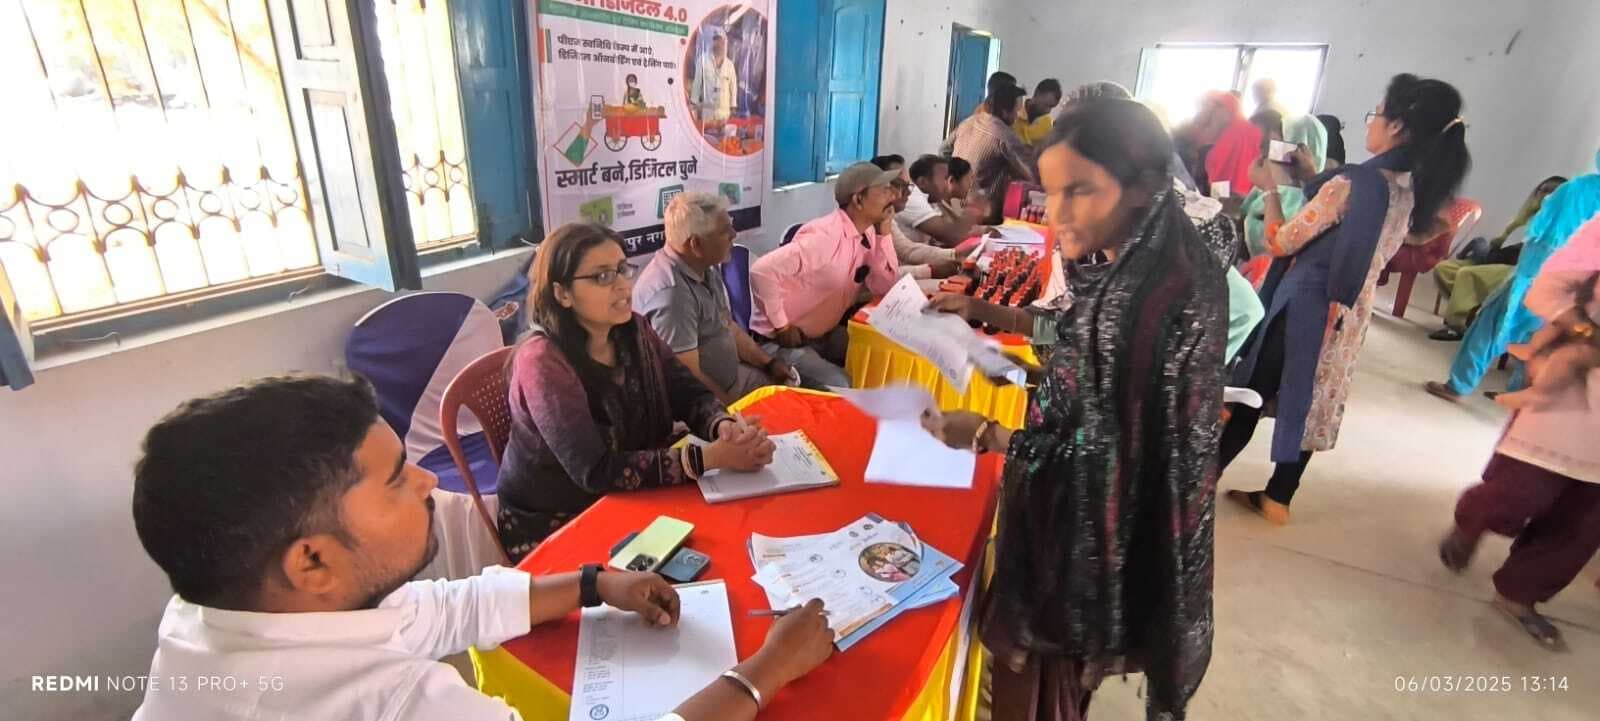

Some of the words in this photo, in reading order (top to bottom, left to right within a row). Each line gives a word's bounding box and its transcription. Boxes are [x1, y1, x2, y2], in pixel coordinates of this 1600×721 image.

[664, 5, 688, 22] 4.0
[555, 161, 598, 188] स्मार्ट
[623, 235, 643, 252] पुर
[645, 230, 664, 244] नग
